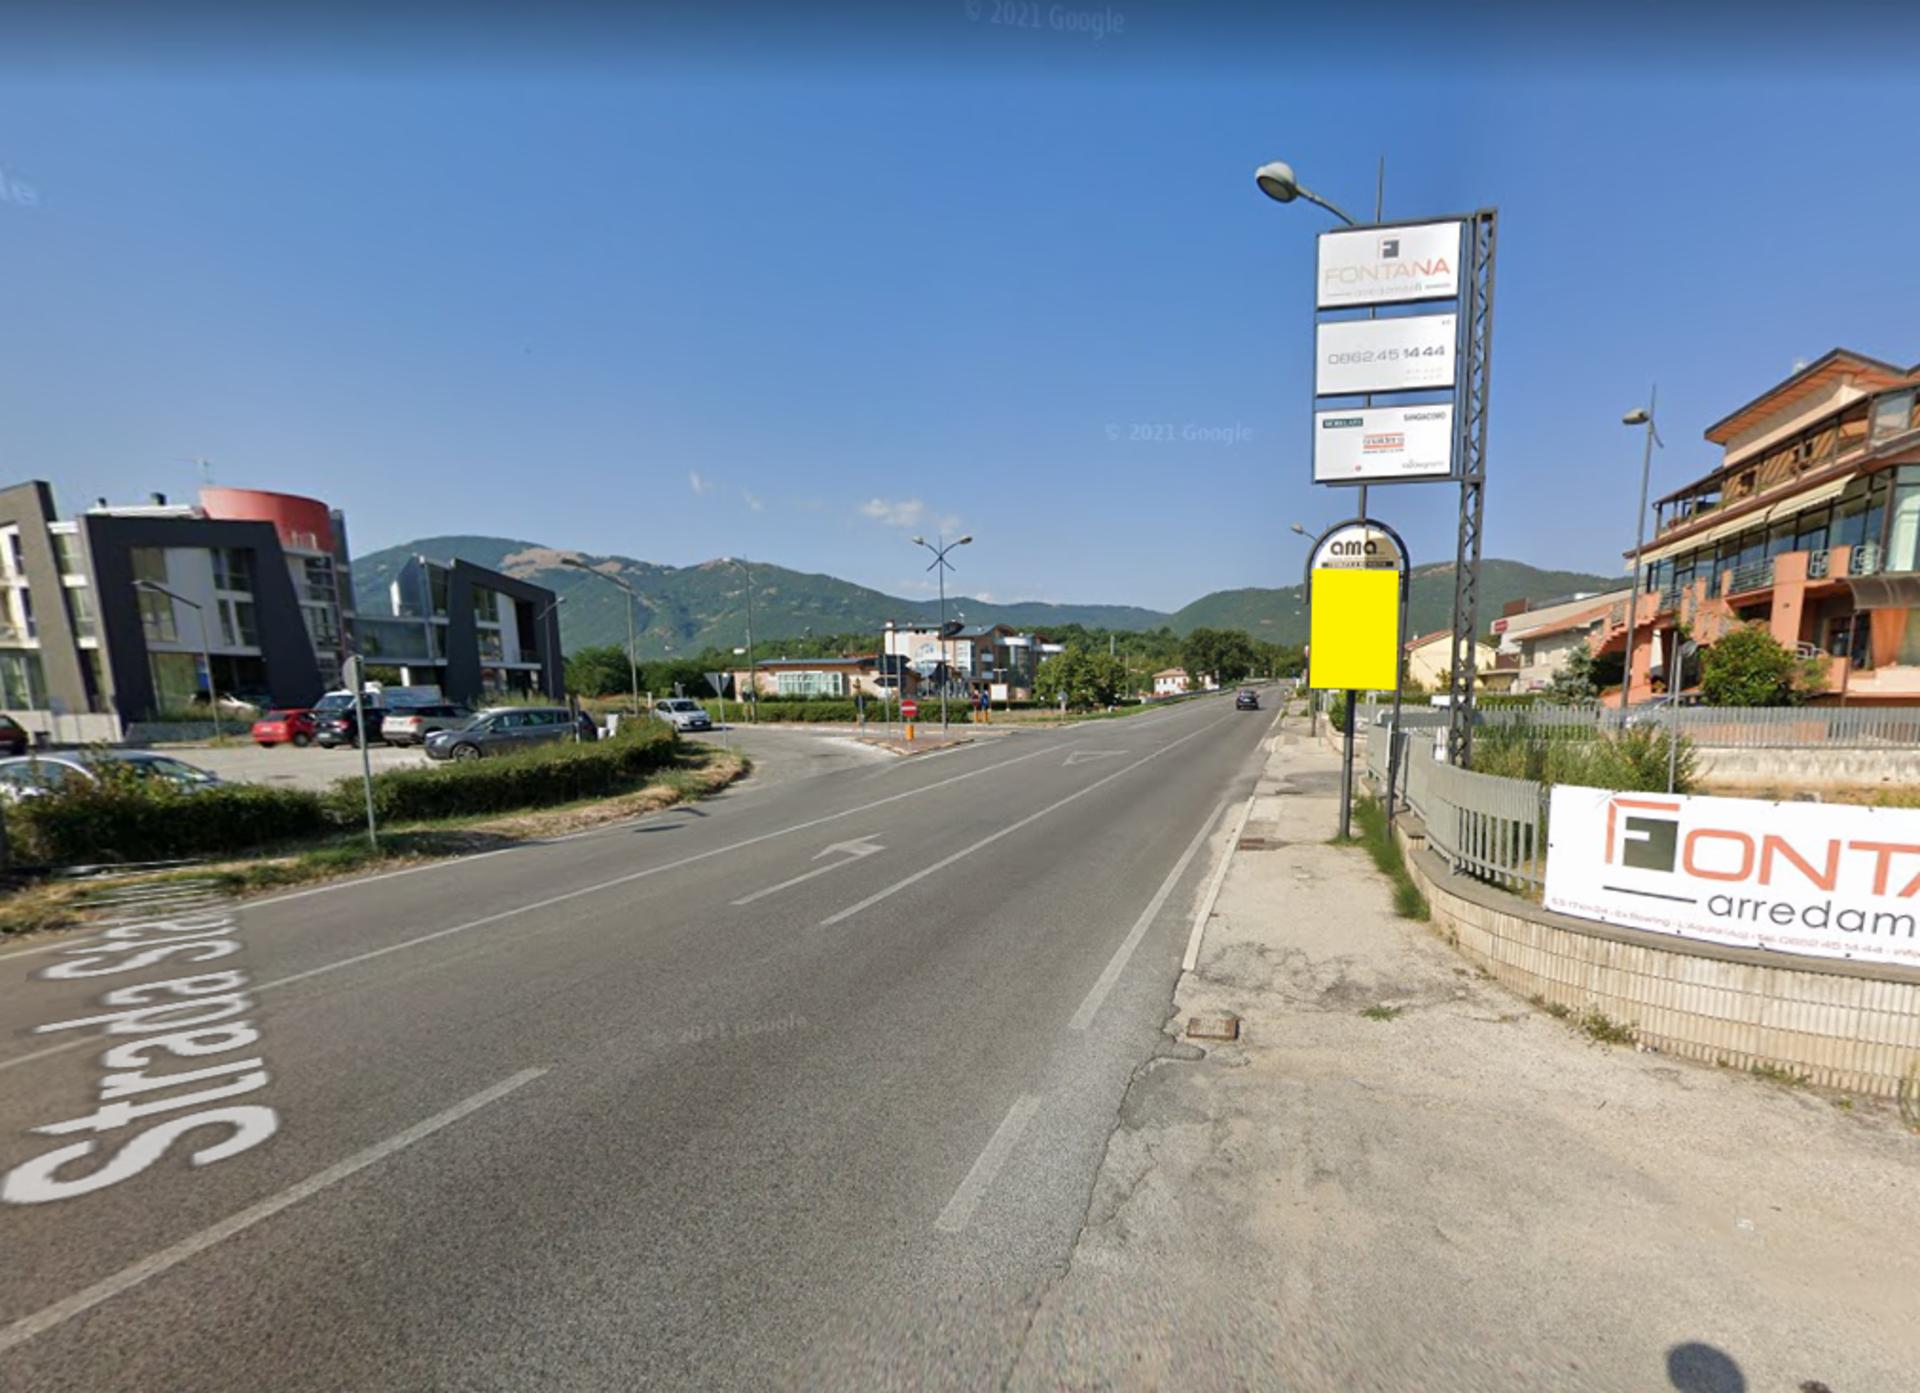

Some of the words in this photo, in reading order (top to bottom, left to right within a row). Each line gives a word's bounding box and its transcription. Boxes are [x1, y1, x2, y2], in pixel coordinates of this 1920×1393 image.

[1324, 257, 1451, 286] FONTANA
[1330, 540, 1378, 556] ama
[1604, 799, 1920, 898] FONT
